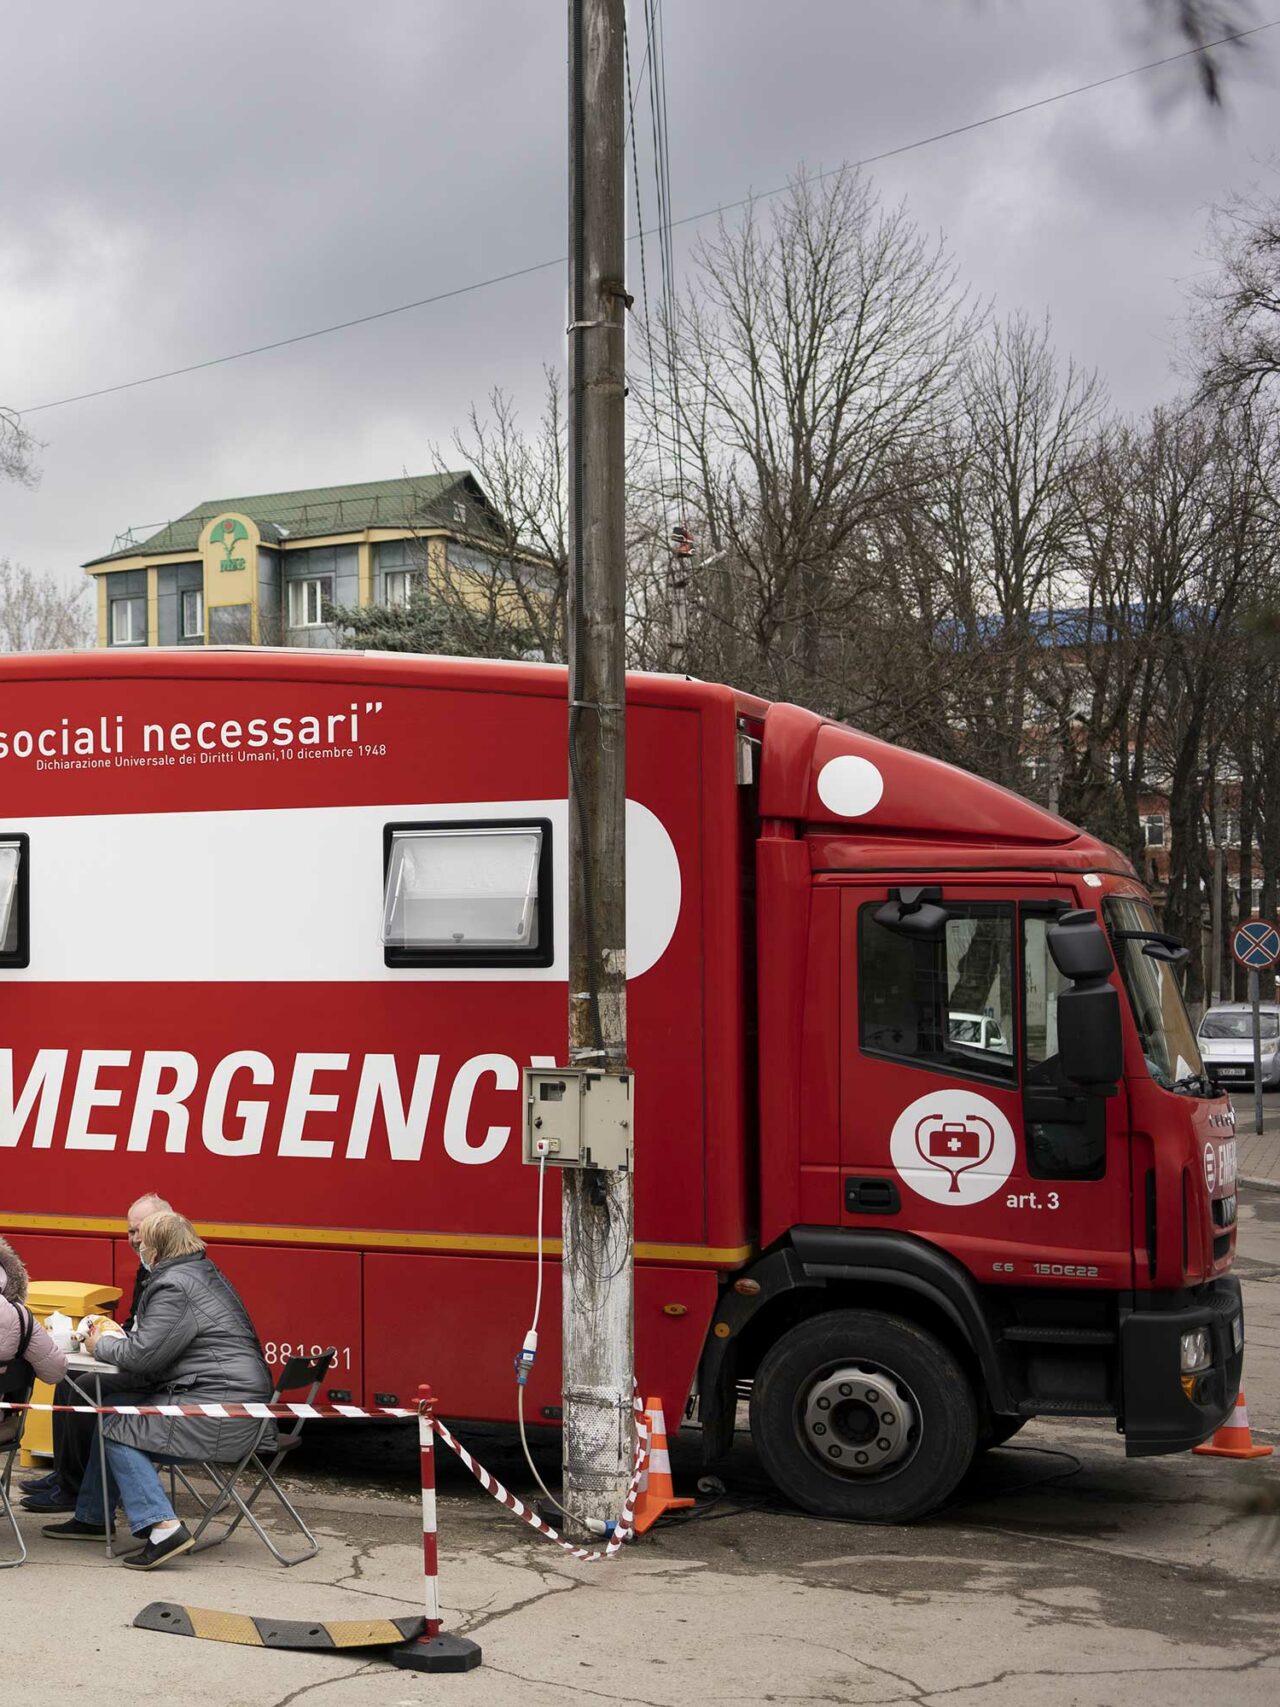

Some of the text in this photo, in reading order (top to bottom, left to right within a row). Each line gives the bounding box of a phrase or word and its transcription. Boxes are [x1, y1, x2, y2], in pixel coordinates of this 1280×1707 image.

[143, 701, 383, 752] necessari”
[36, 756, 111, 771] Dichiarazione
[115, 753, 175, 767] Universale
[179, 753, 196, 765] dei
[200, 750, 234, 764] Diritti
[297, 746, 354, 760] dicembre
[358, 744, 387, 756] 1948
[1006, 1191, 1060, 1210] art. 3
[1034, 1263, 1099, 1277] 150E22
